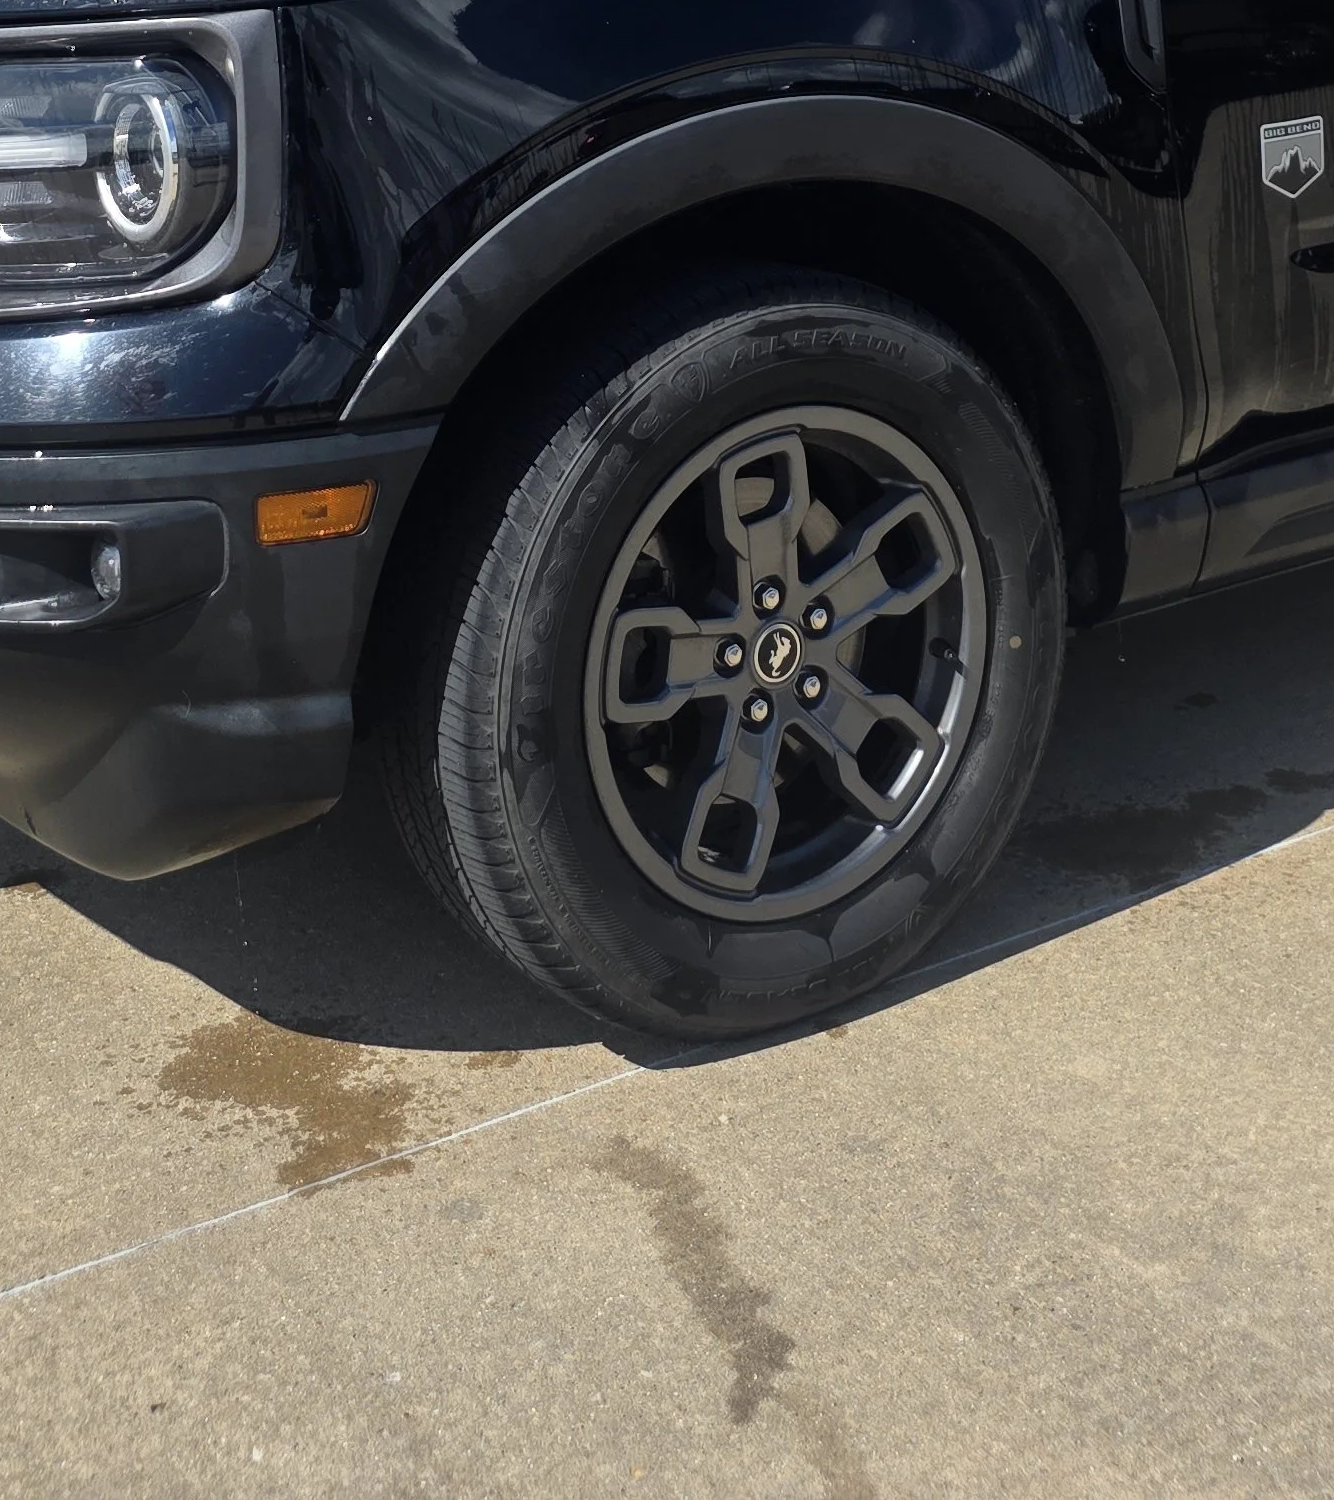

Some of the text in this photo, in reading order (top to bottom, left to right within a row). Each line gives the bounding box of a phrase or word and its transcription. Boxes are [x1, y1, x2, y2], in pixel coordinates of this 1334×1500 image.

[1264, 121, 1320, 138] BIG BEND
[792, 328, 907, 361] SEASON
